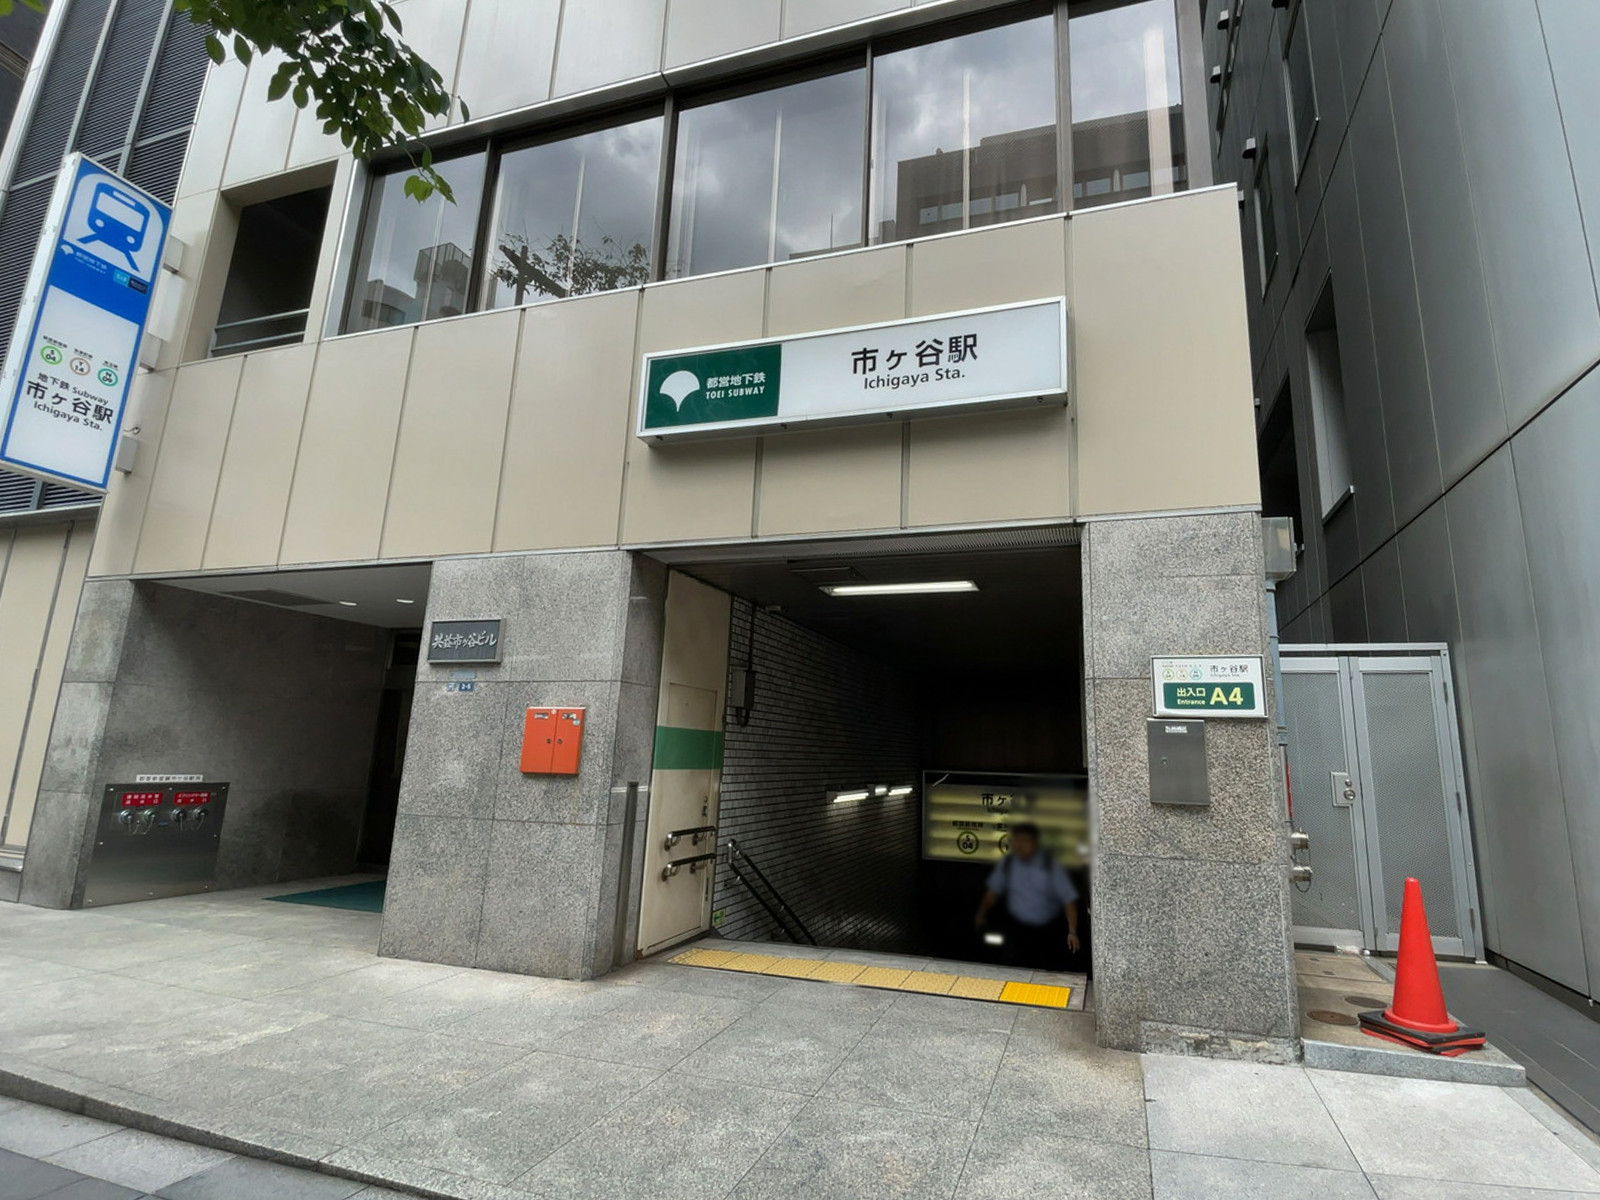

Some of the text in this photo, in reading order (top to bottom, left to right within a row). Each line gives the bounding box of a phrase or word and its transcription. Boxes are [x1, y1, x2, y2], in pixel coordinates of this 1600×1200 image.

[851, 333, 978, 375] 市ヶ谷駅
[37, 372, 109, 405] 地下鉄 Subway
[706, 371, 766, 389] 都営地下鉄
[864, 368, 965, 389] Ichigaya Sta.
[26, 380, 113, 424] 市ヶ谷駅
[706, 386, 765, 399] TOEI SUBWAY
[33, 401, 102, 431] Ichigaya Sta.
[1177, 687, 1243, 705] 出入口 A4
